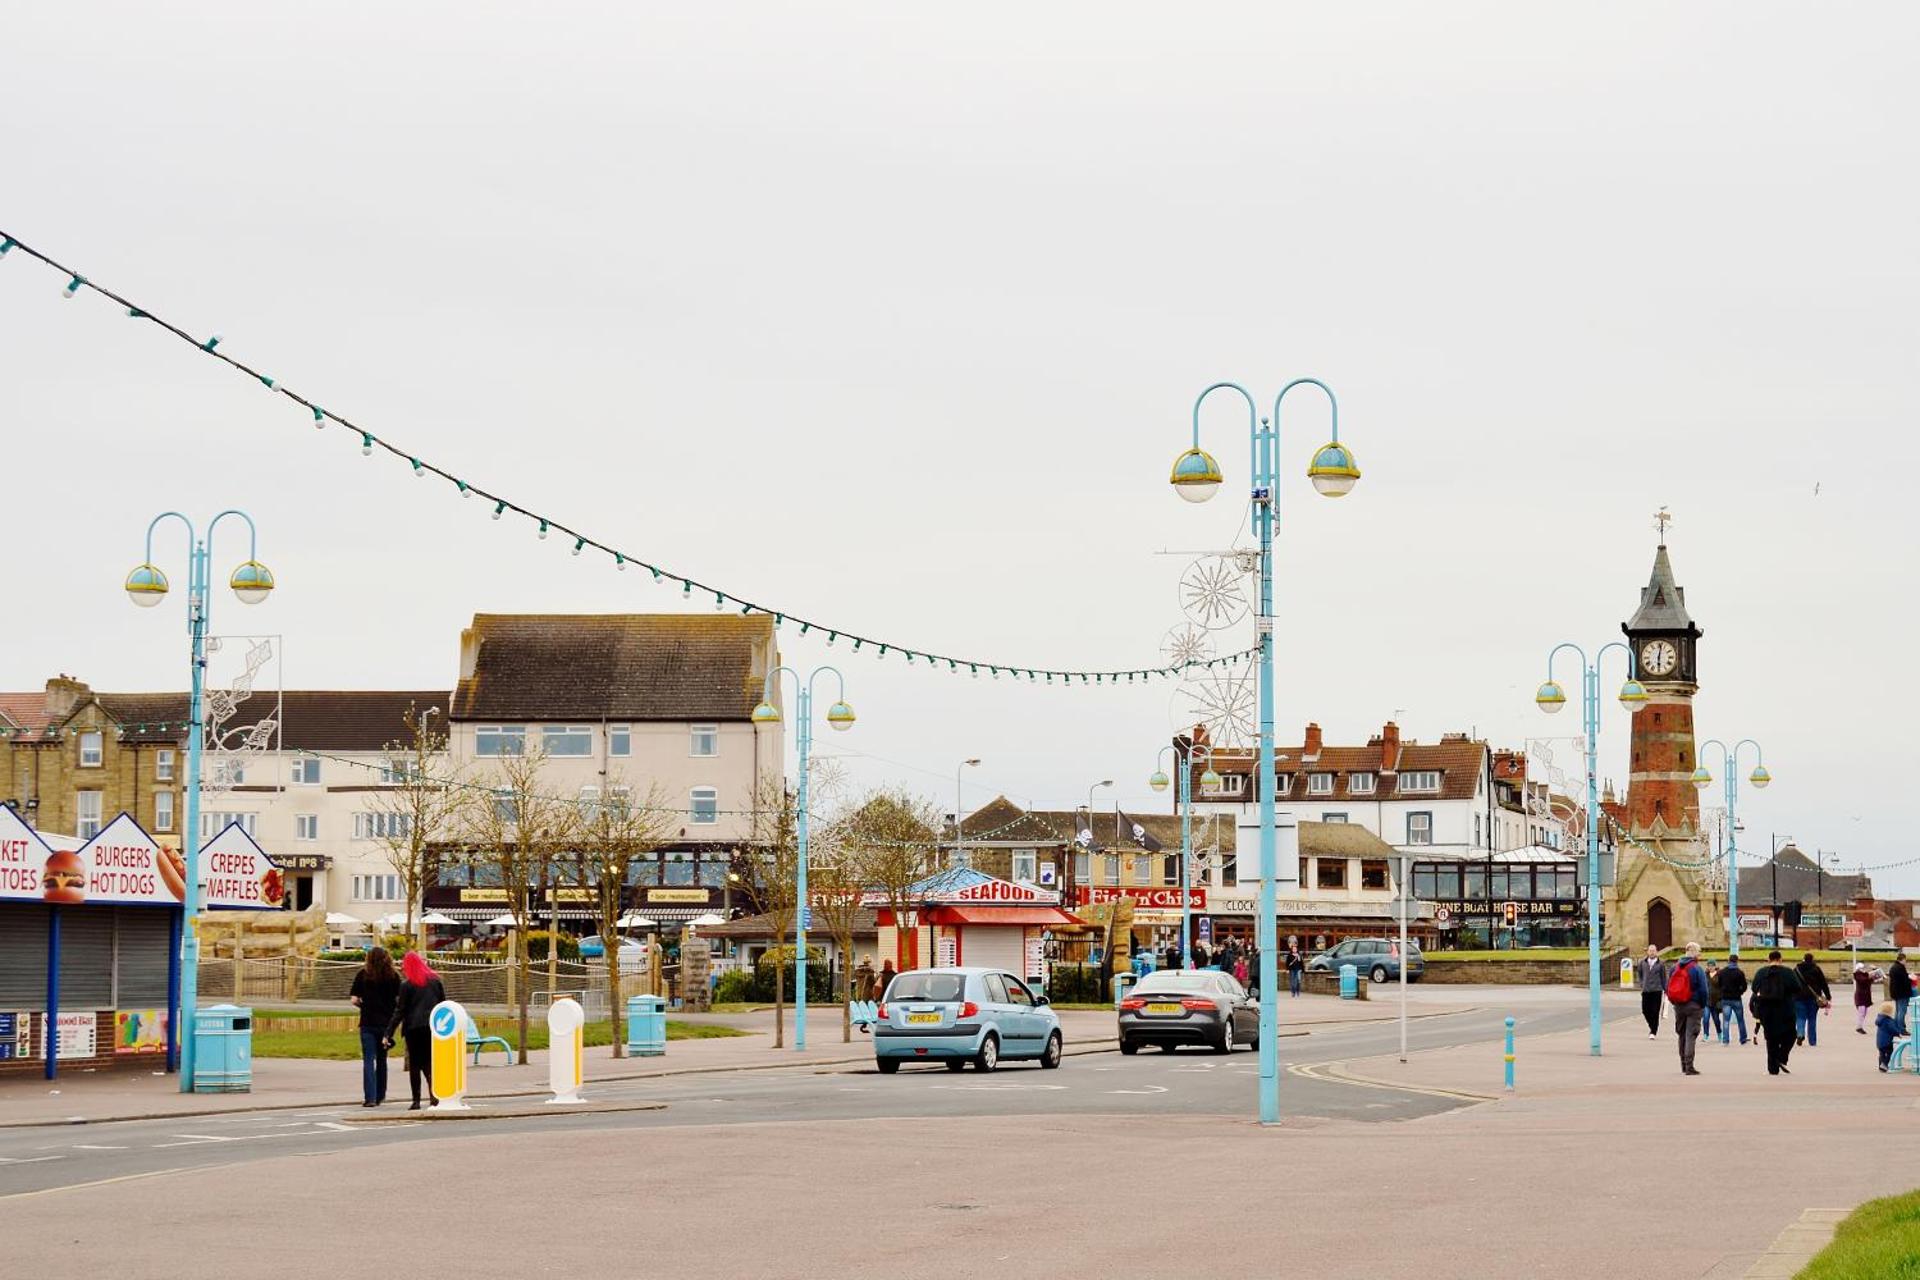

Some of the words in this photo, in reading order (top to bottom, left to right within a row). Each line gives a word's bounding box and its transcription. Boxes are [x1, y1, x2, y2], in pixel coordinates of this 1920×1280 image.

[95, 845, 151, 868] BURGERS
[210, 853, 255, 875] CREPES
[90, 872, 116, 893] HOT
[120, 873, 155, 895] DOGS
[959, 882, 1035, 900] SEAFOOD
[1226, 900, 1256, 911] CLOCK
[1494, 903, 1529, 914] HOSE
[1531, 903, 1553, 914] BAR
